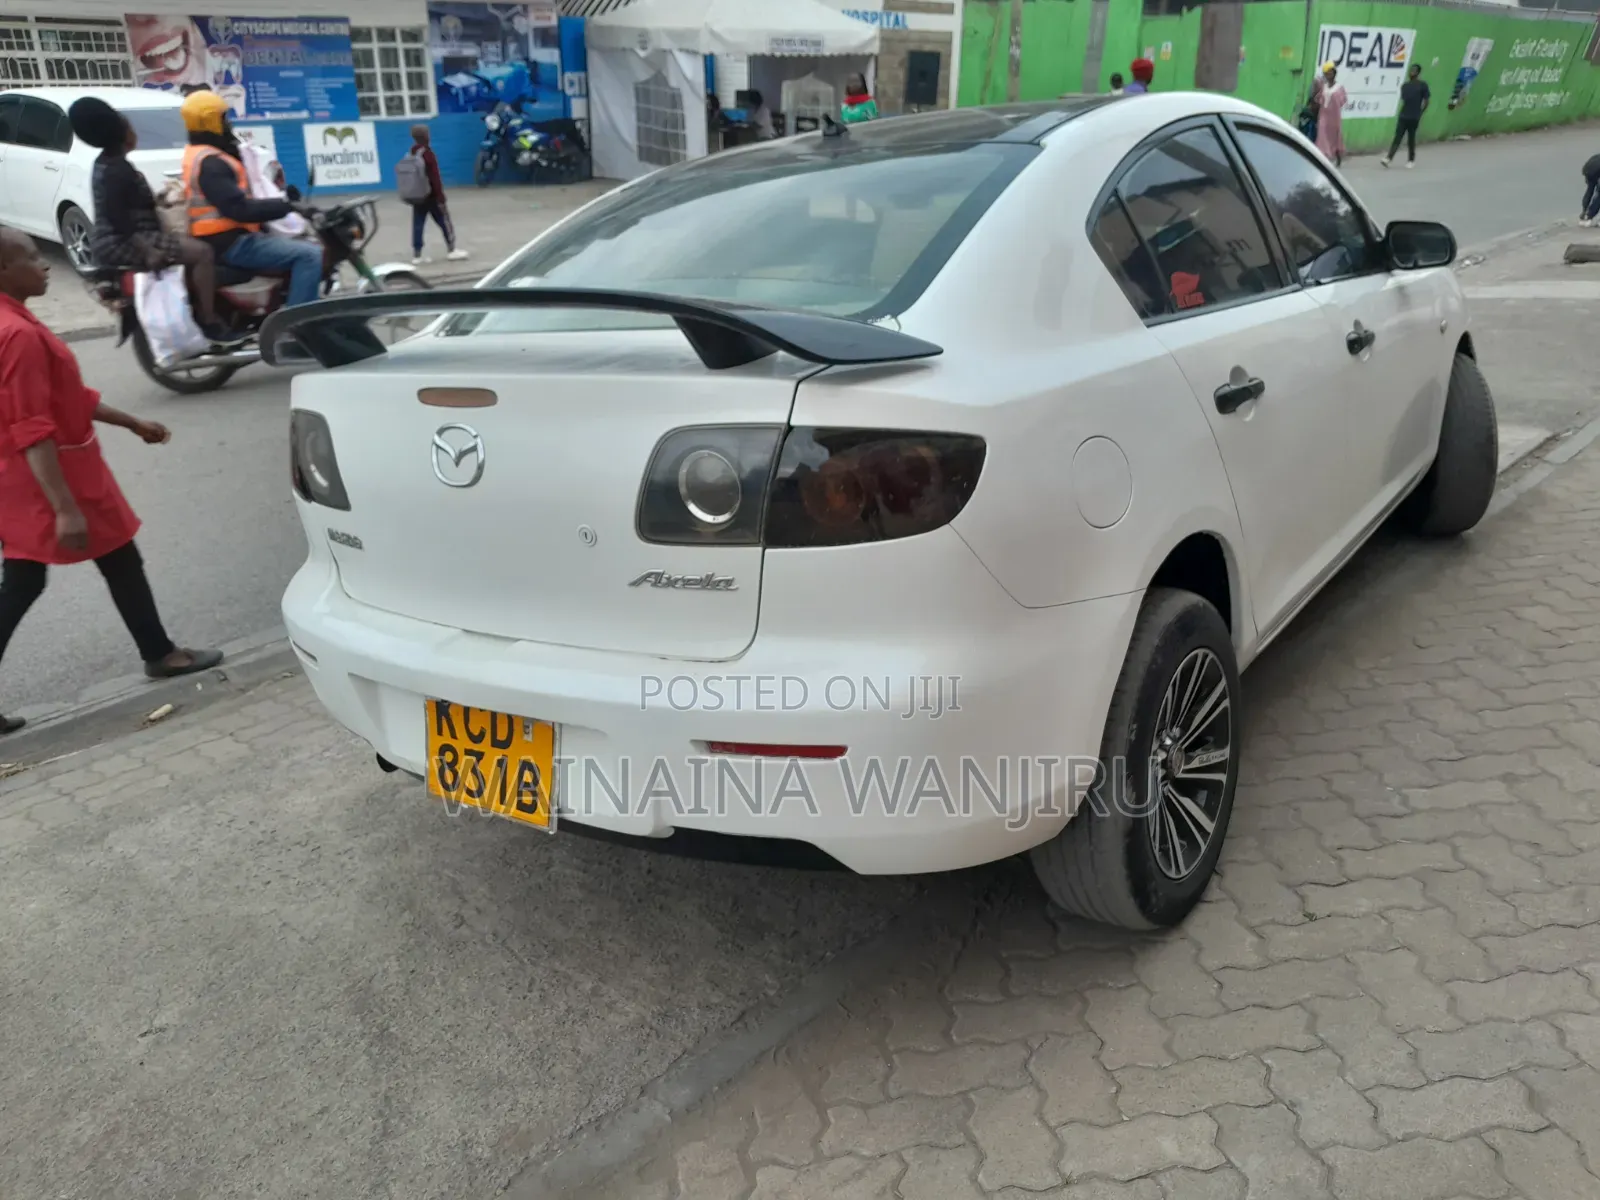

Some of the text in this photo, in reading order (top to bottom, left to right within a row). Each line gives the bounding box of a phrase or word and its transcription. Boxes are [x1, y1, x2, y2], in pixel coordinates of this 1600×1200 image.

[1318, 30, 1405, 68] IDEAL
[627, 569, 739, 591] Axela
[435, 699, 514, 750] KCD
[438, 743, 540, 815] 831B
